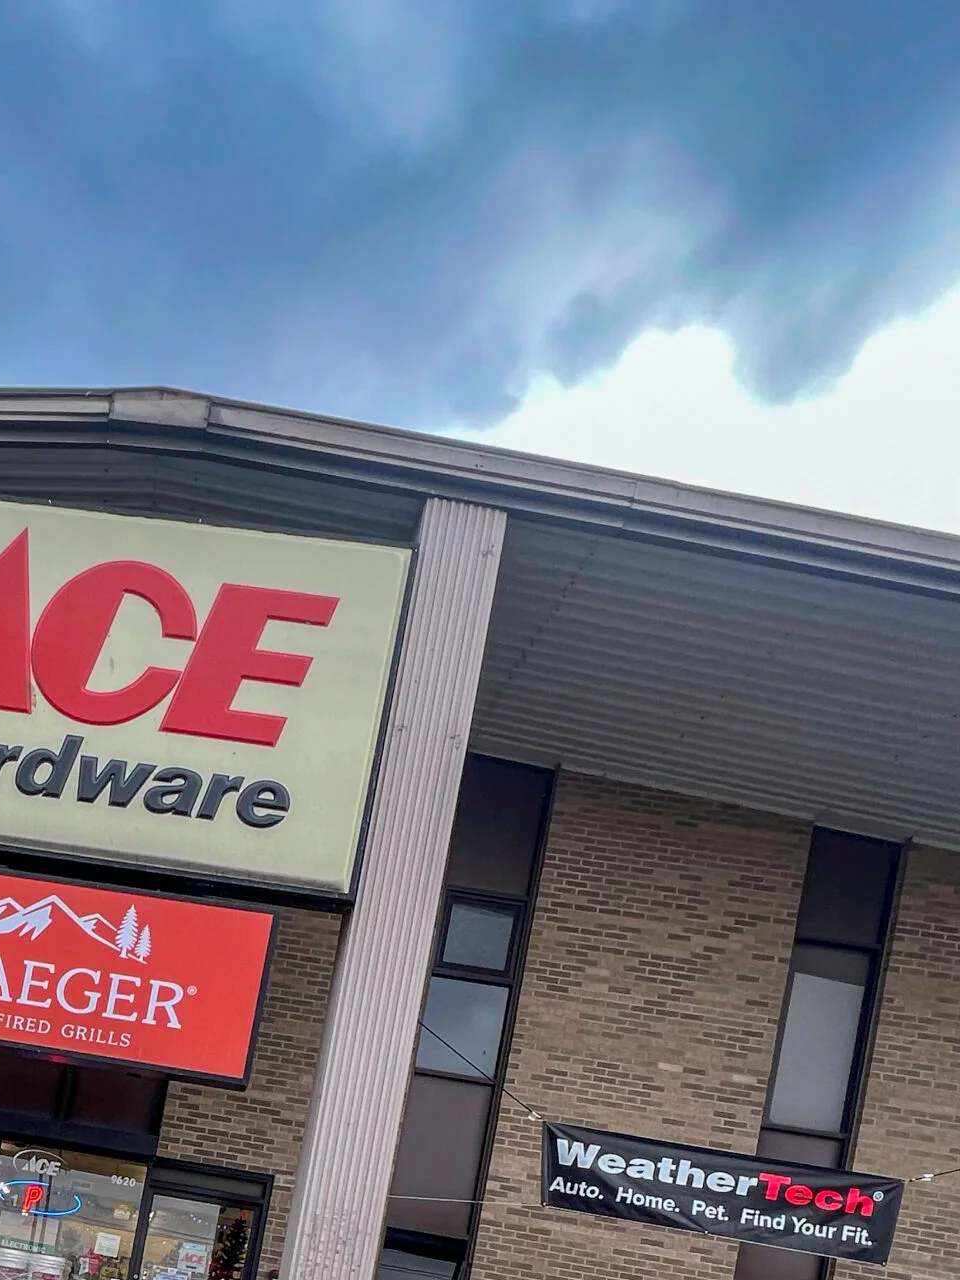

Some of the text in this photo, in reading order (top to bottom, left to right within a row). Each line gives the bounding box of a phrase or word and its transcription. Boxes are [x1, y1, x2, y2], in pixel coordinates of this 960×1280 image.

[61, 1023, 132, 1048] GRILLS
[21, 1155, 61, 1176] ACE
[111, 1174, 136, 1187] 9620
[548, 1176, 873, 1247] Auto. Home. Pet. Find Your Fit.
